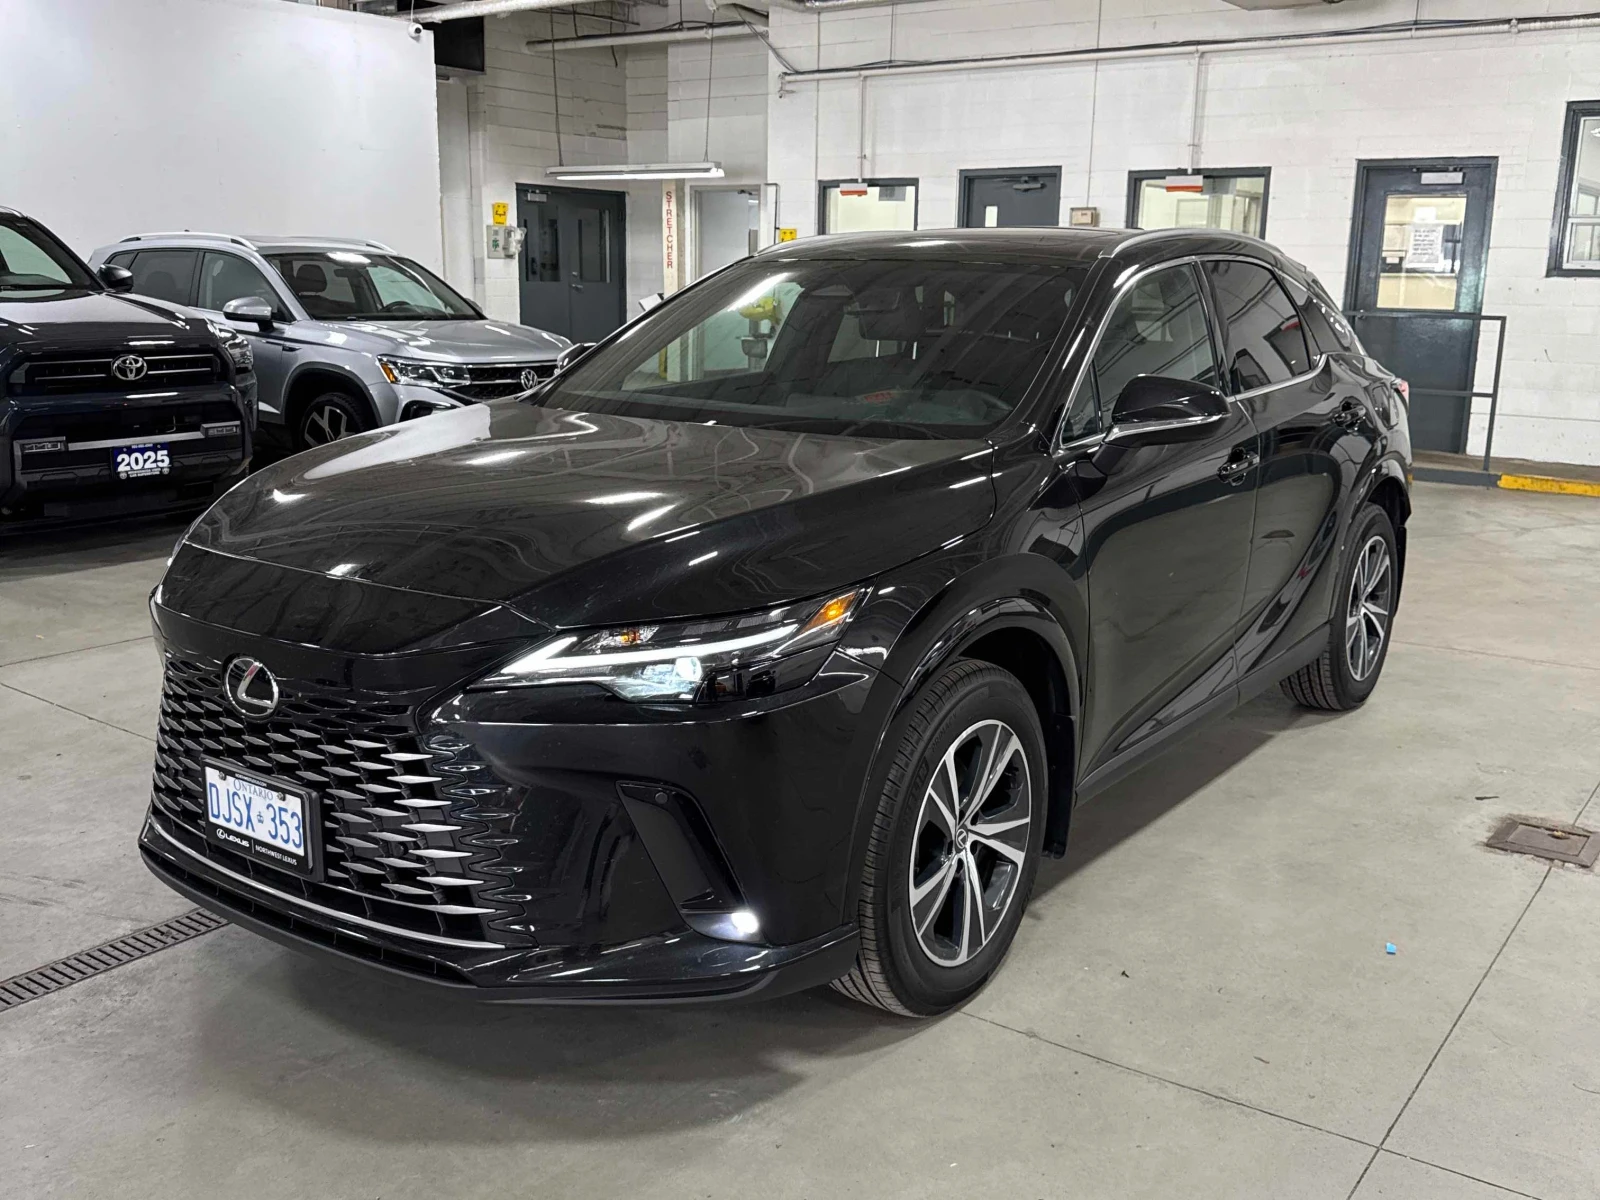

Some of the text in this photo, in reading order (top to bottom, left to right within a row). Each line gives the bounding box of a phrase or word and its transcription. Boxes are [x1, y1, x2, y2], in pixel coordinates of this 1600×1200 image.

[665, 191, 673, 269] STRETCHER
[117, 450, 170, 472] 2025
[233, 778, 274, 801] ONTARIO
[209, 782, 303, 849] DJSX 353
[225, 833, 250, 848] LEXUS
[255, 844, 297, 866] NORTHWEST LEXUS
